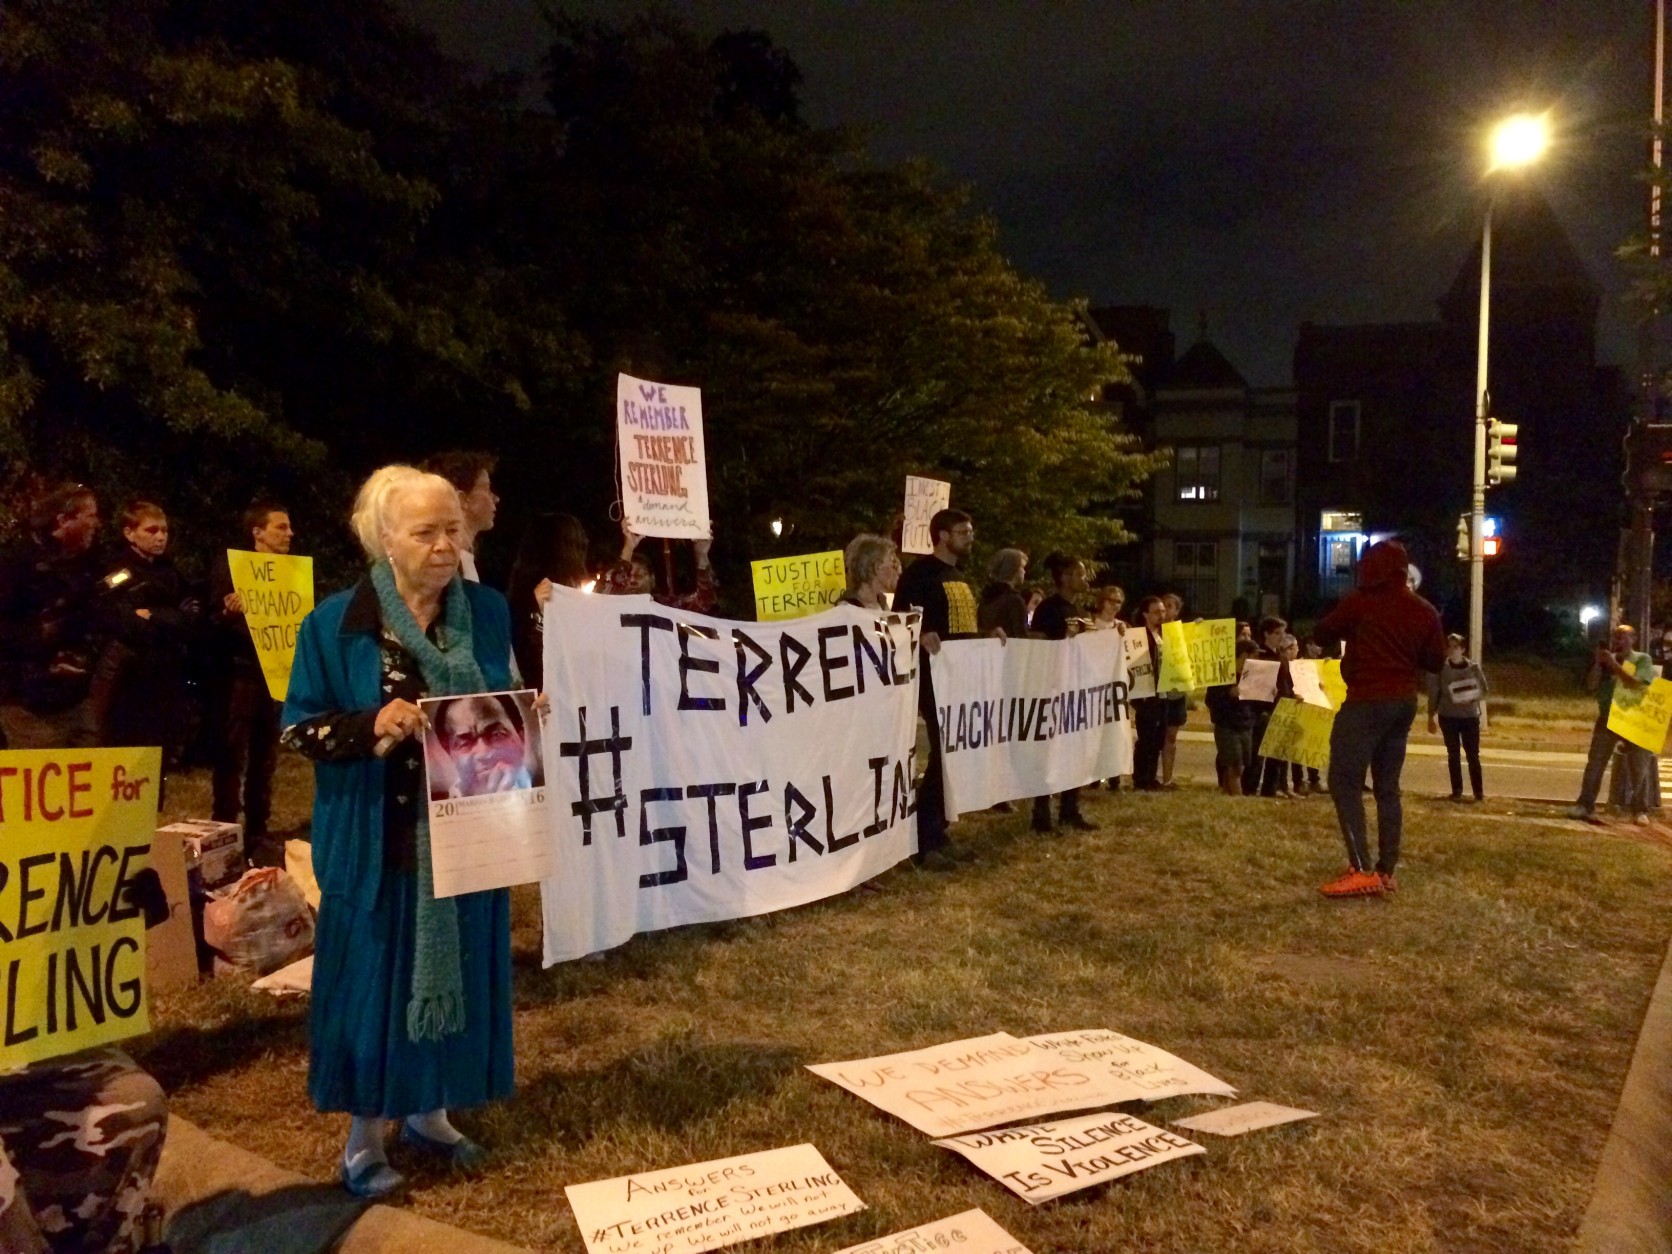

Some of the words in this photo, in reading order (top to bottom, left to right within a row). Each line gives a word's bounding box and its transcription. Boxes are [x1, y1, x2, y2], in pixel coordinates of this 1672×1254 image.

[639, 384, 667, 403] WE
[623, 400, 690, 431] REMEMBER
[633, 434, 698, 464] TERRENCE
[250, 560, 276, 582] WE
[762, 557, 842, 584] JUSTICE
[792, 579, 821, 593] FOR
[238, 587, 301, 617] DEMAND
[110, 764, 150, 802] for
[434, 802, 455, 818] 20
[836, 1065, 906, 1089] WE
[921, 1043, 1033, 1075] DEMAND
[905, 1067, 1090, 1112] ANSWERS
[1031, 1116, 1148, 1155] SILENCE
[1041, 1132, 1194, 1180] VIOLENCE
[626, 1164, 756, 1203] ANSWERS
[657, 1214, 732, 1241] remember
[804, 1190, 831, 1203] not
[687, 1234, 713, 1246] We
[719, 1222, 742, 1238] will
[749, 1216, 772, 1230] not
[779, 1213, 799, 1225] go
[807, 1202, 847, 1216] away
